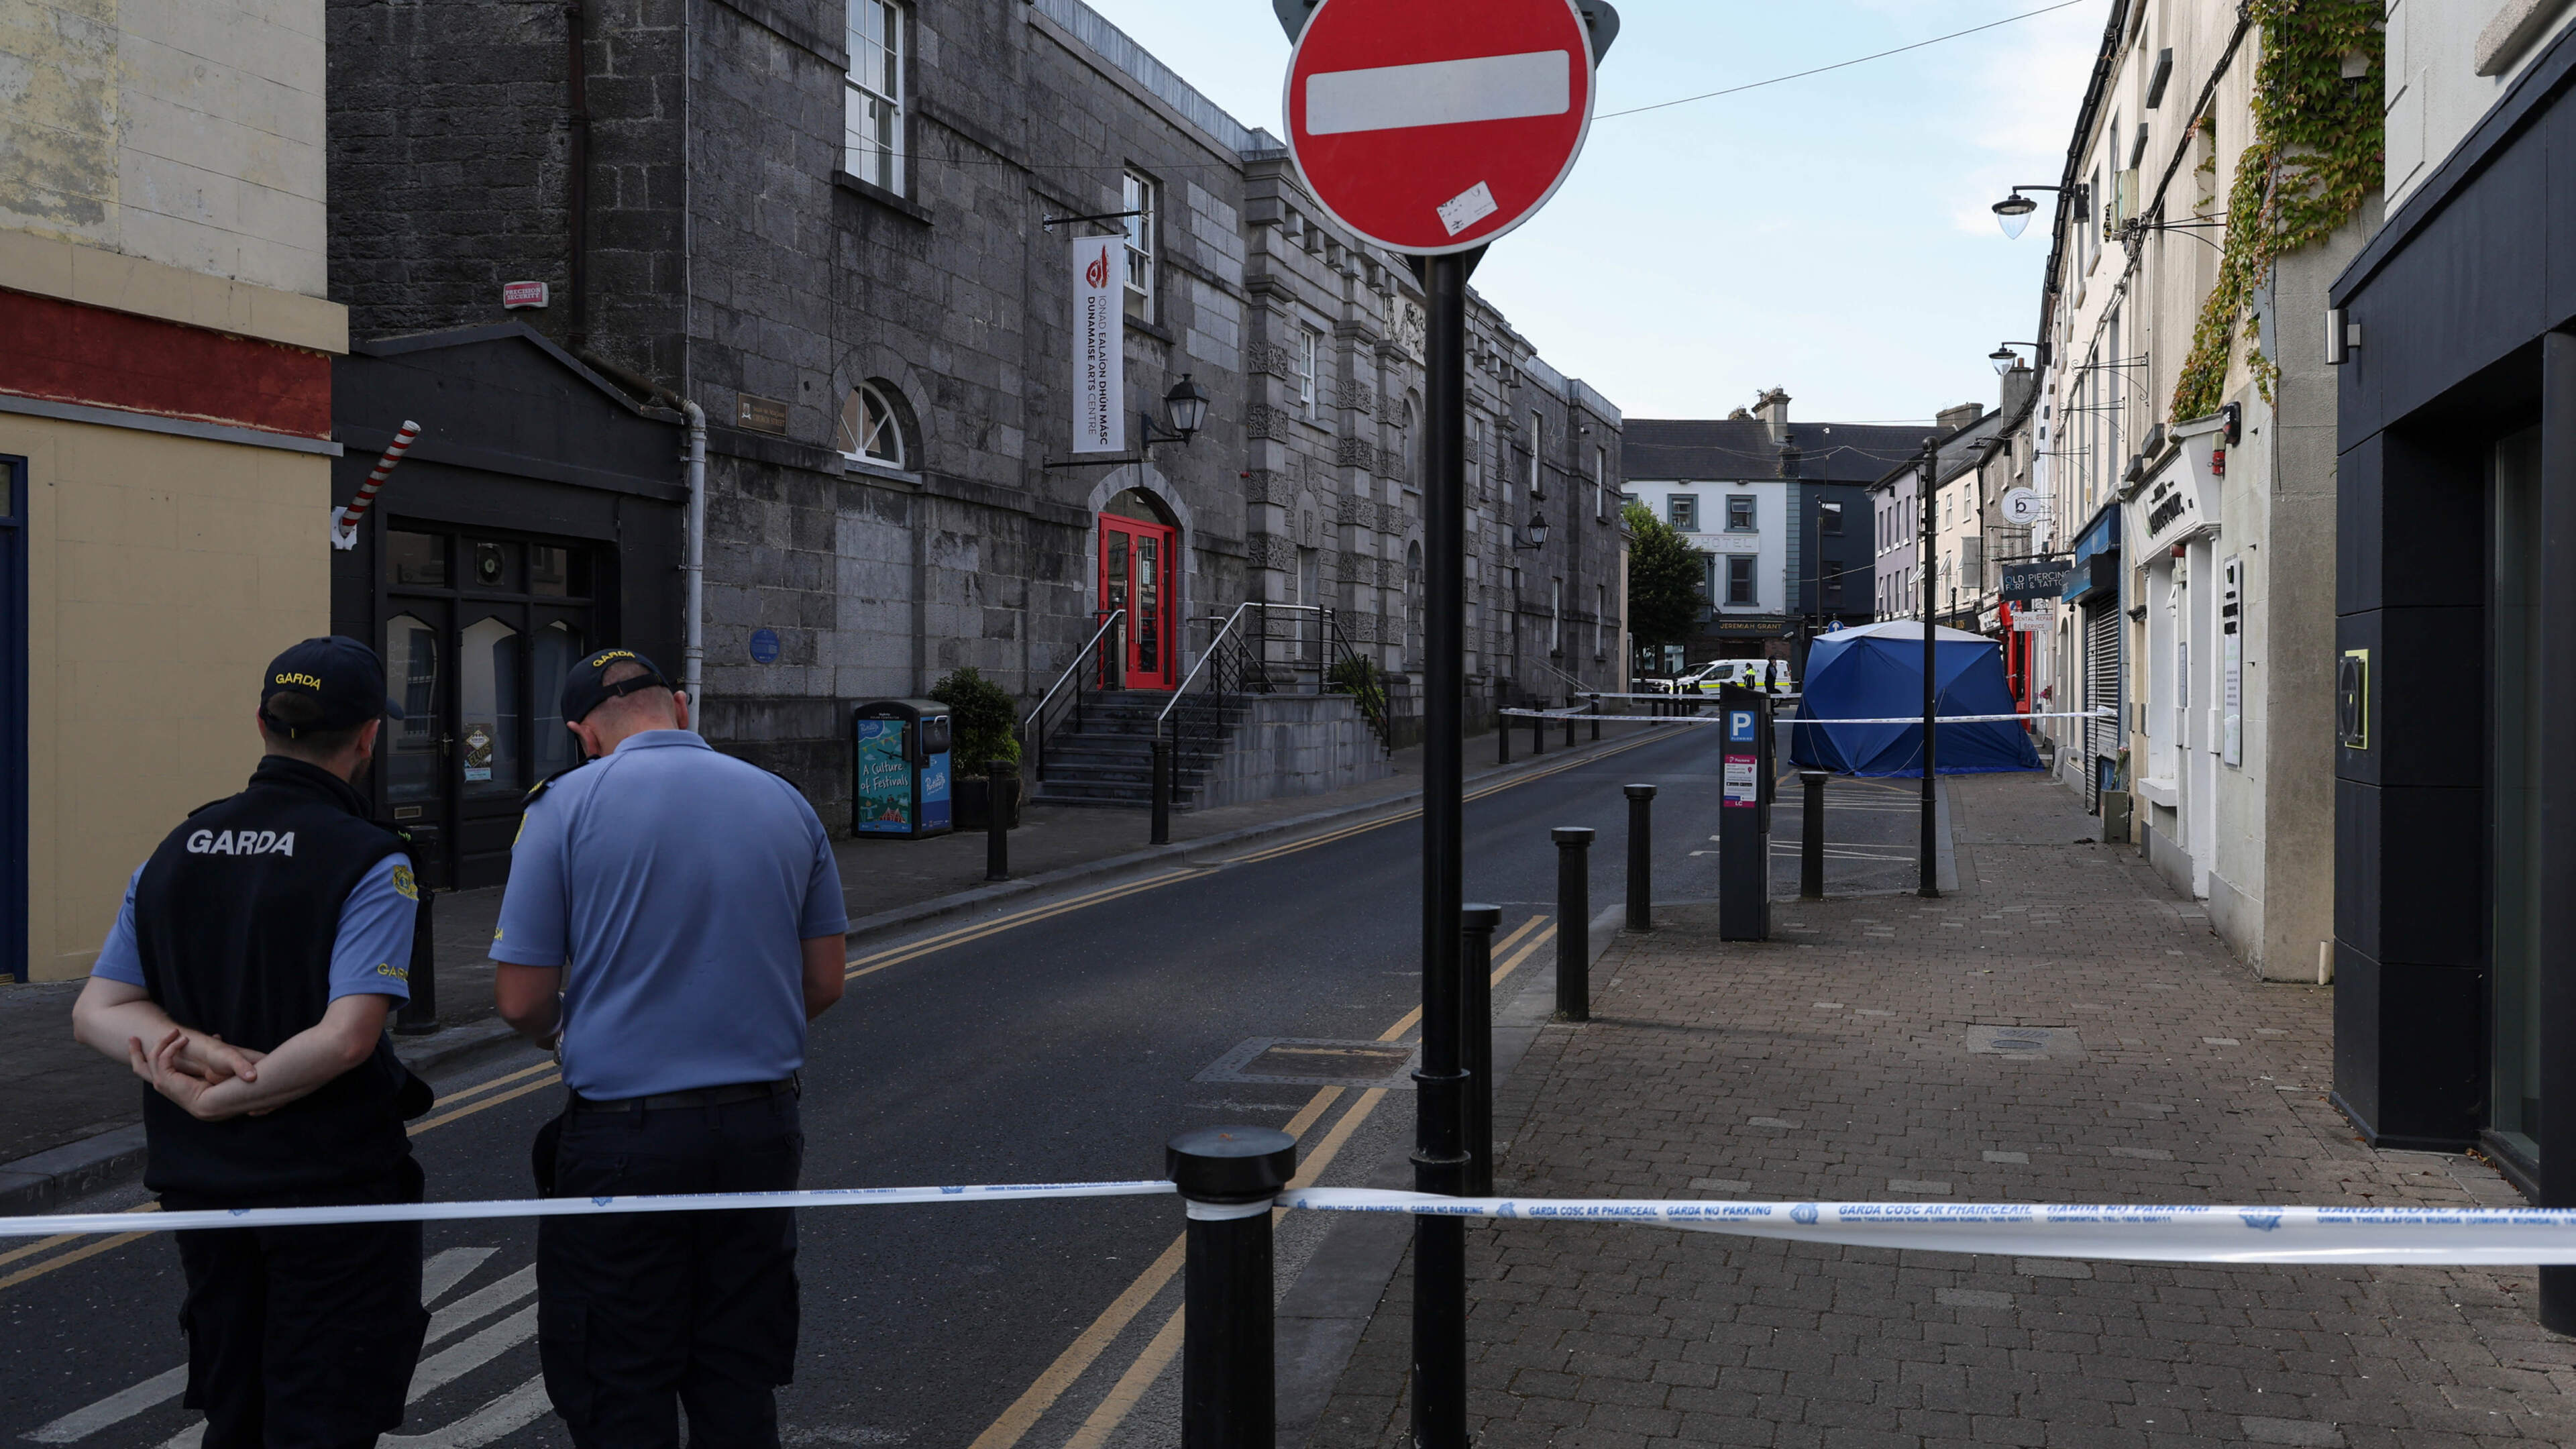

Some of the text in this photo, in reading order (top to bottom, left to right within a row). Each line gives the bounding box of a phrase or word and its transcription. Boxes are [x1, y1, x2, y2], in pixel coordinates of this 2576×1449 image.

[506, 287, 541, 296] PRECISION
[1087, 297, 1097, 435] DUNAMAISE ARTS CENTRE
[1098, 296, 1110, 445] IONAD EALAÍON DHÚN MÁSC
[1701, 538, 1752, 548] HOTEL
[2004, 575, 2025, 585] OLD
[2039, 579, 2063, 588] TATT
[2005, 583, 2025, 591] FORT
[592, 651, 636, 667] GARDA
[276, 672, 321, 691] GARDA
[1733, 712, 1752, 736] P
[863, 760, 902, 776] A Culture
[861, 774, 908, 794] of Festivals
[186, 829, 295, 857] GARDA
[1411, 1205, 1436, 1214] GARDA
[1450, 1206, 1484, 1214] PARKING
[1529, 1206, 1772, 1216] GARDA COSC AR PHAIRCEAIL GARDA NO PARKING
[1839, 1205, 1881, 1216] GARDA
[1885, 1205, 1921, 1215] COSC
[1924, 1205, 1944, 1215] AR
[1947, 1205, 2033, 1215] PHAIRCEAIL
